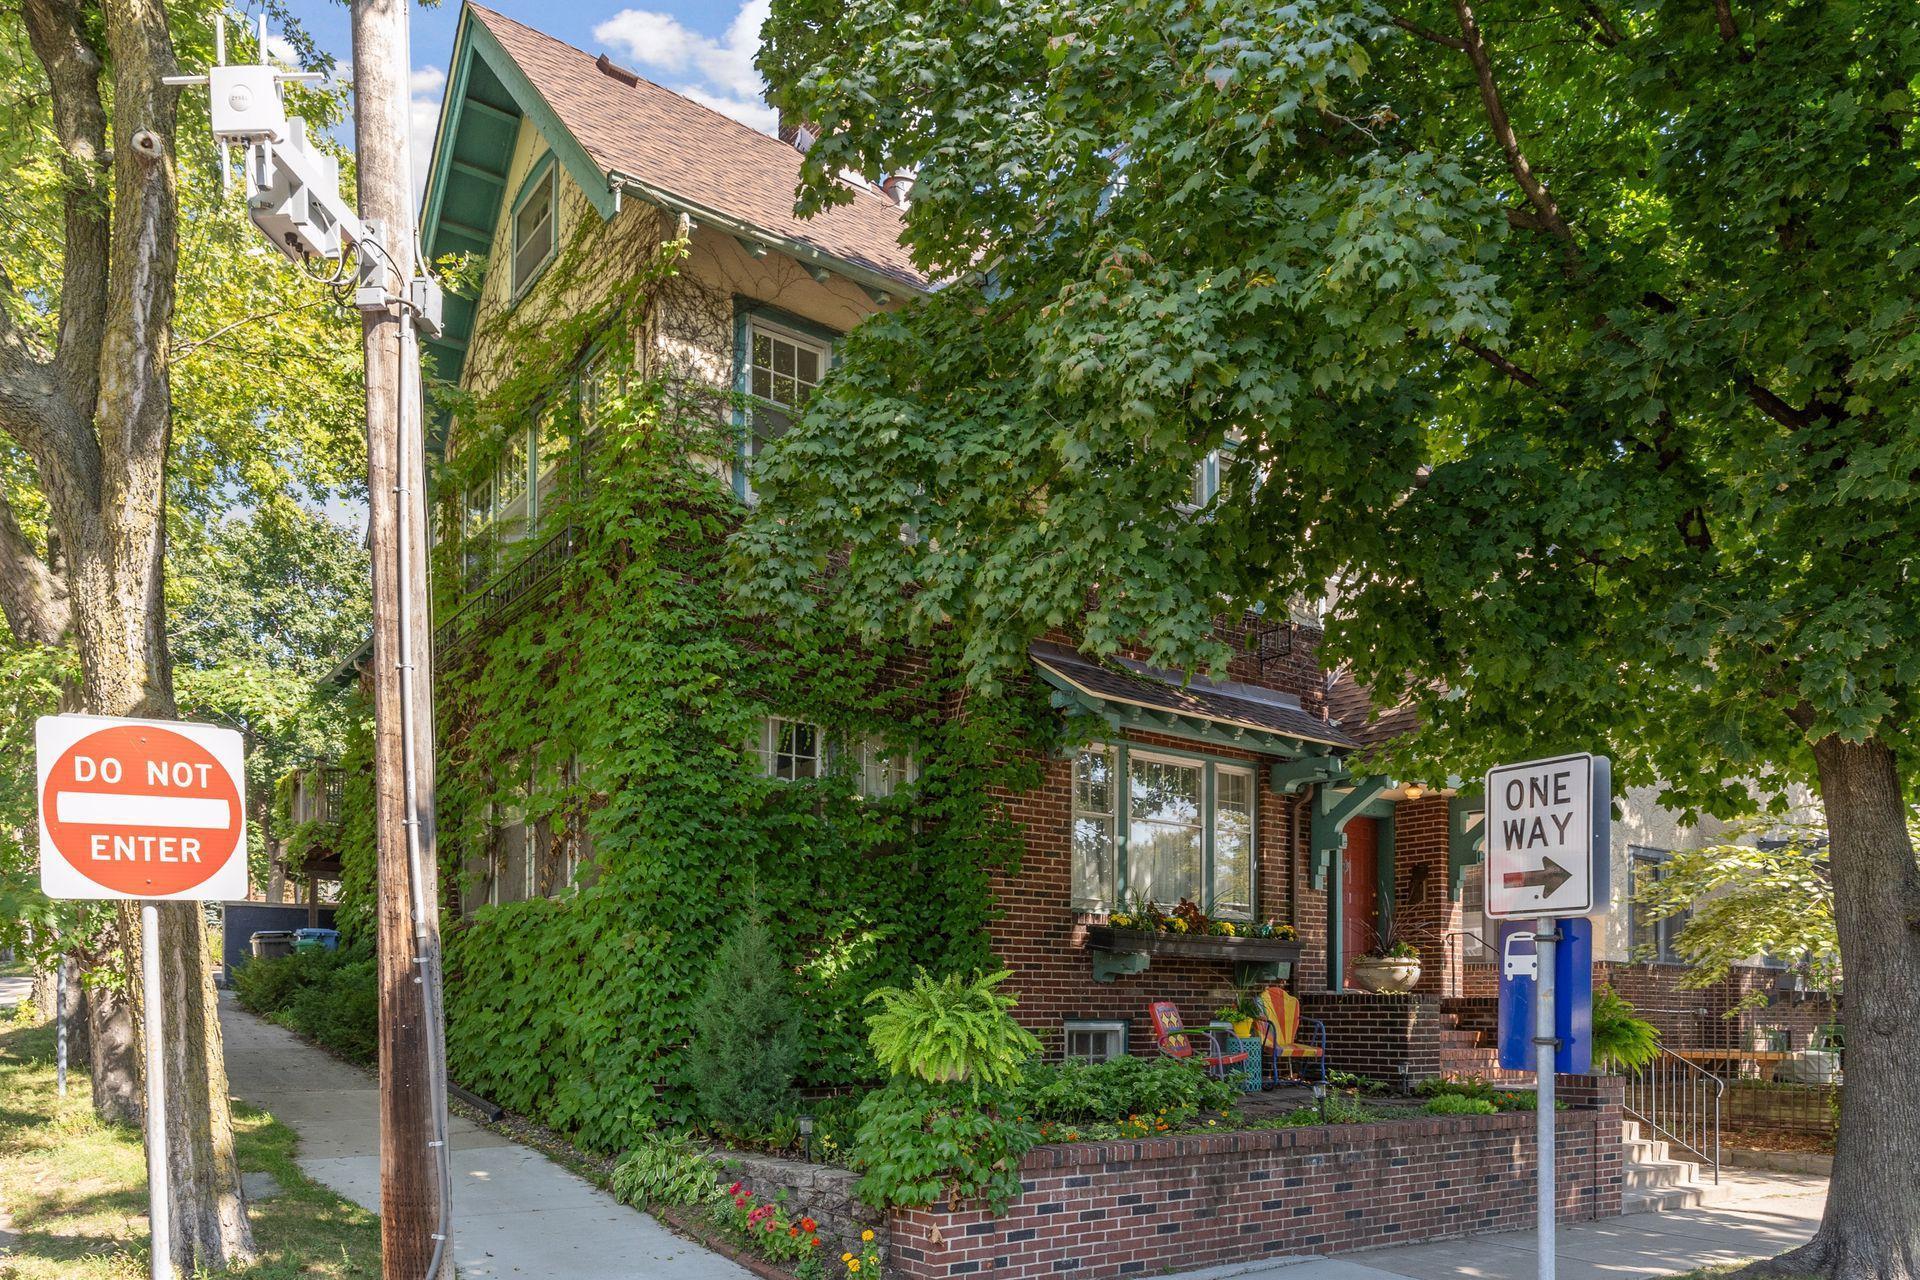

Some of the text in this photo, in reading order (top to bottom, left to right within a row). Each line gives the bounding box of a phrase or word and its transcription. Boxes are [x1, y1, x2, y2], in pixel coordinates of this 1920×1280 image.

[74, 755, 213, 789] DO NOT
[1505, 770, 1571, 811] ONE
[90, 834, 202, 864] ENTER
[1502, 811, 1574, 851] WAY
